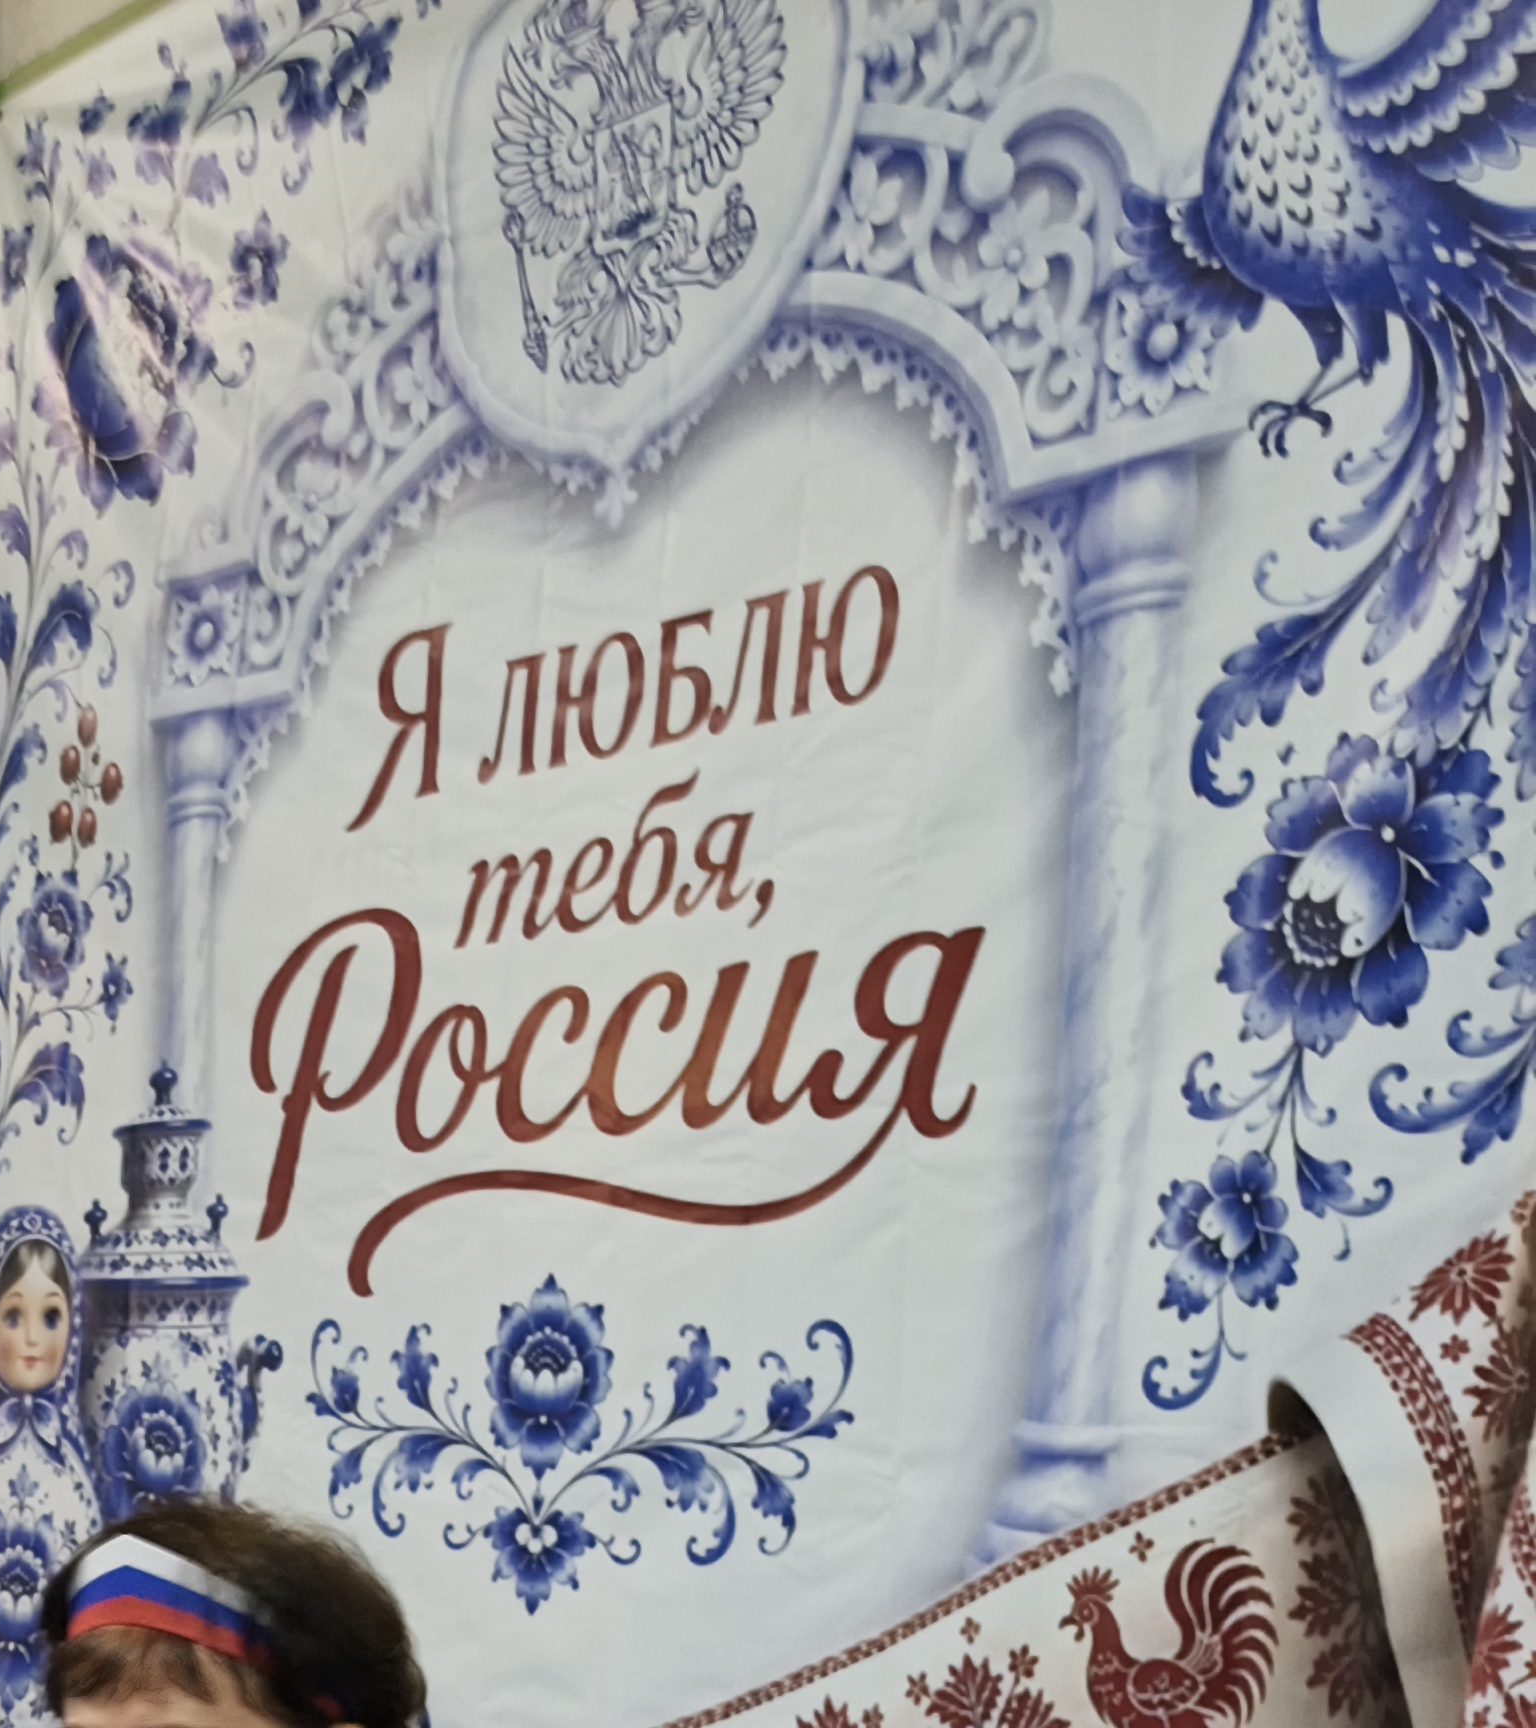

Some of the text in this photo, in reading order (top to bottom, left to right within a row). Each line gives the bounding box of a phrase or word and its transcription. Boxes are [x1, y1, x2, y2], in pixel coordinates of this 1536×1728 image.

[346, 622, 452, 832] Я
[454, 768, 776, 949] тебя,
[250, 906, 986, 1244] Россия
